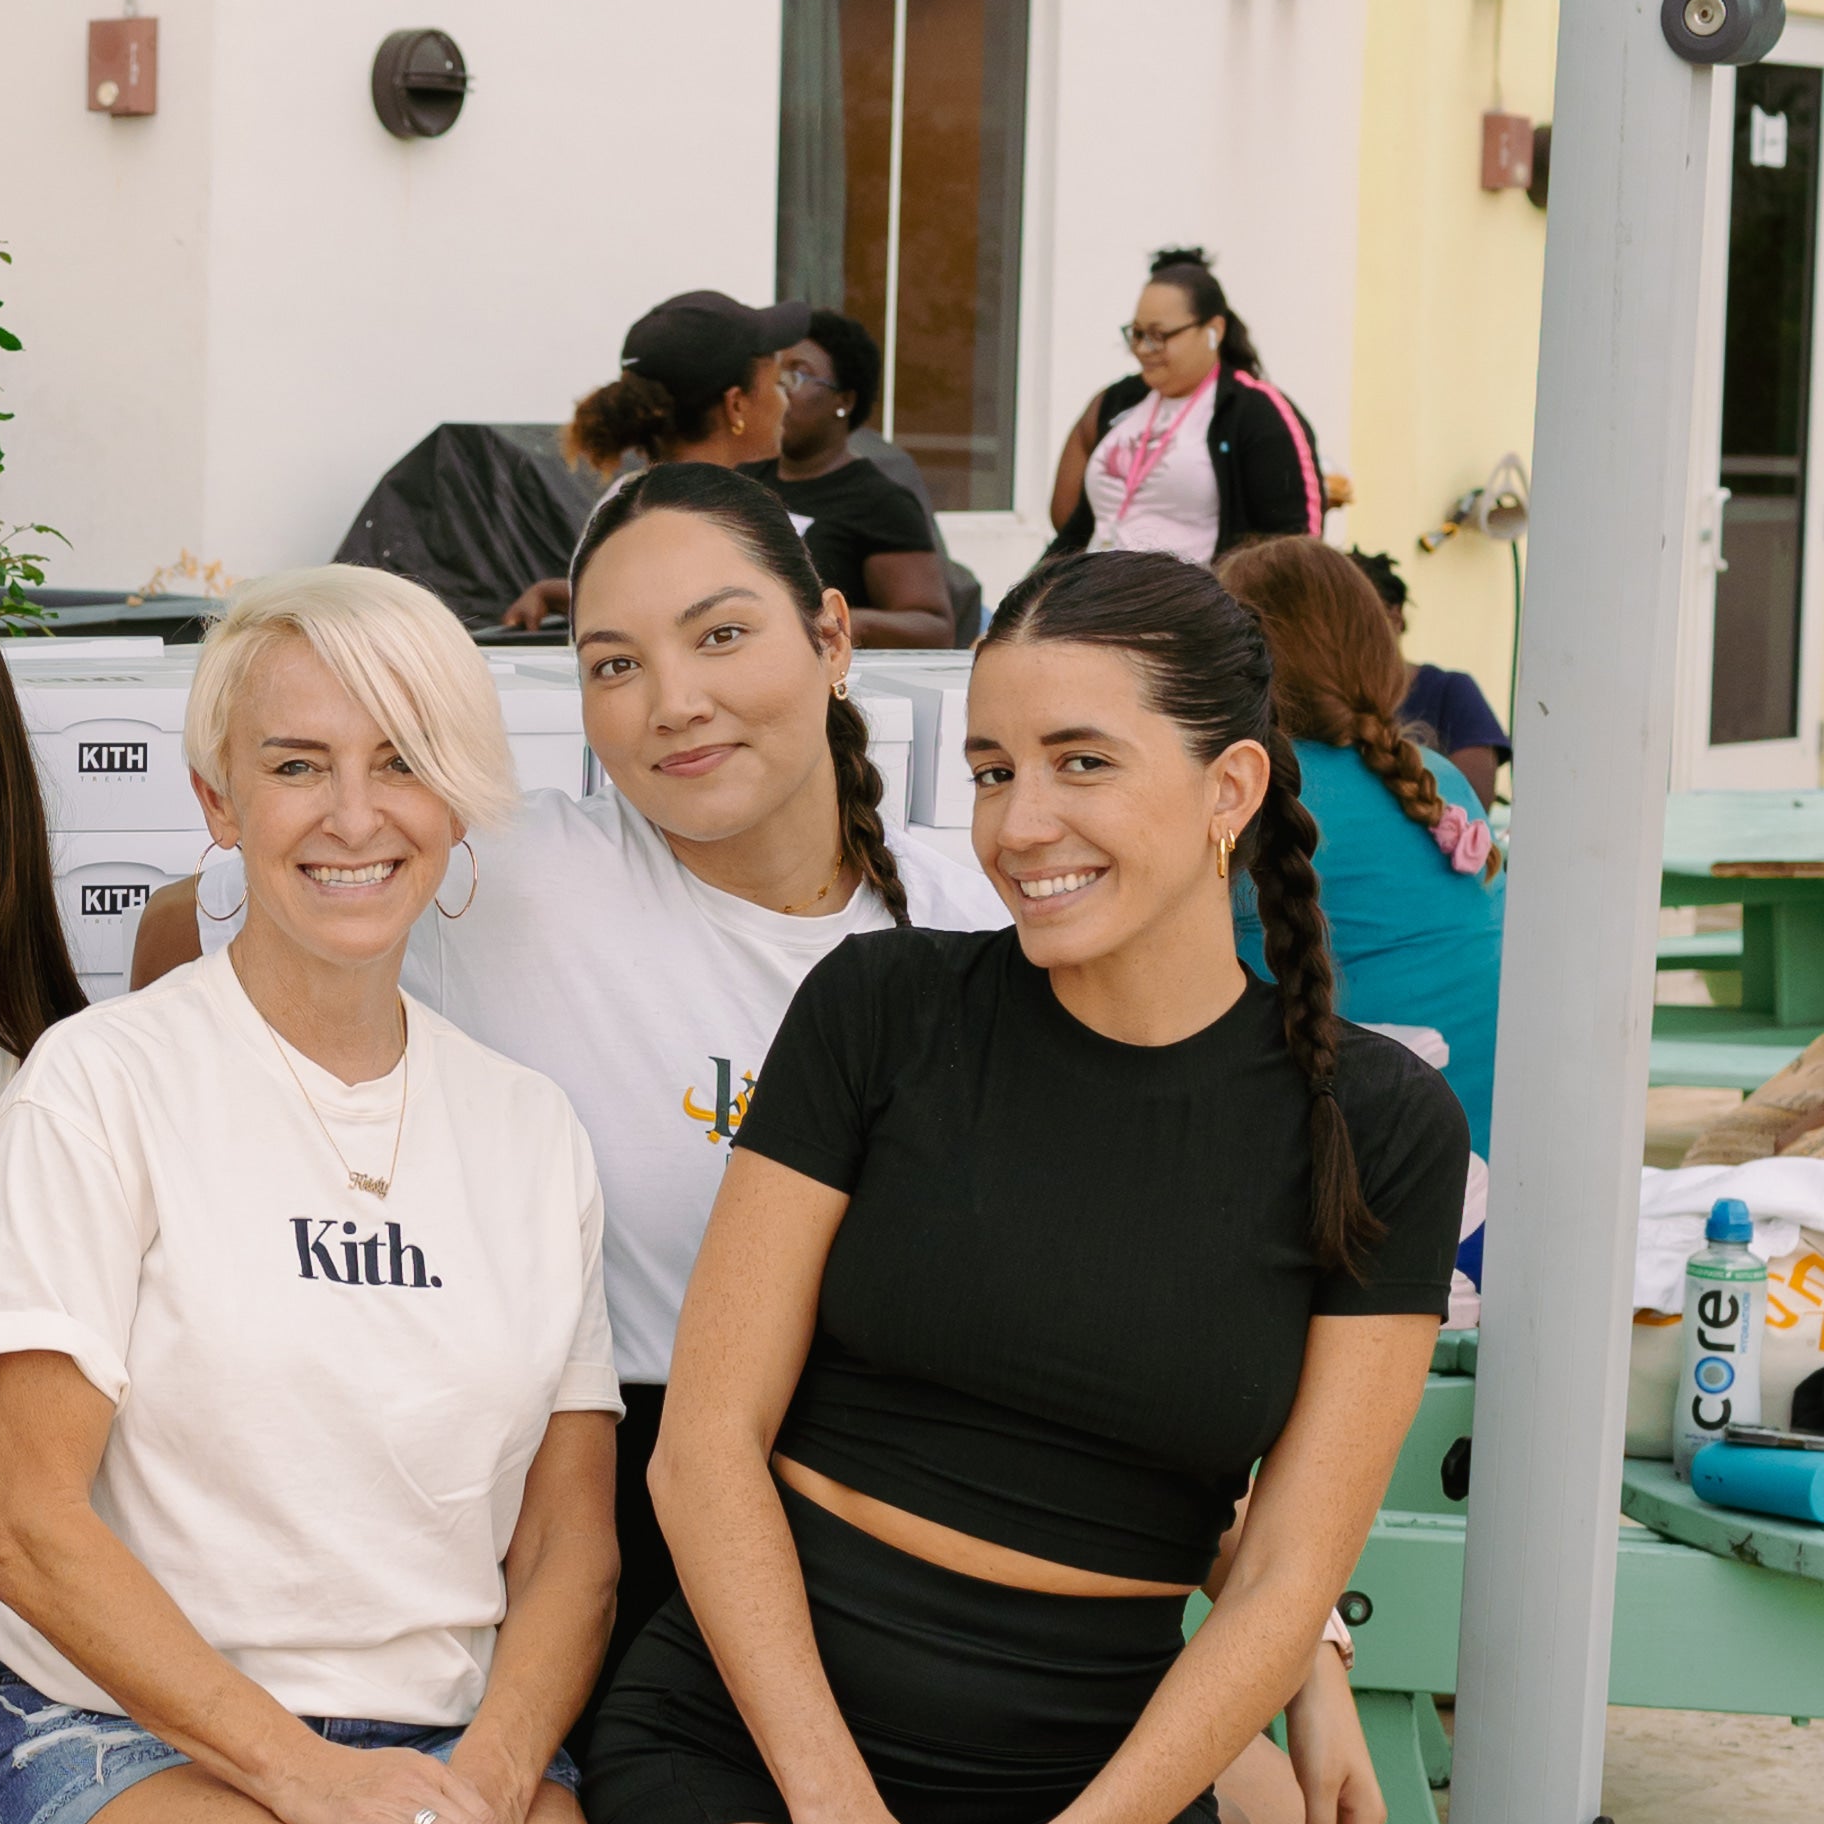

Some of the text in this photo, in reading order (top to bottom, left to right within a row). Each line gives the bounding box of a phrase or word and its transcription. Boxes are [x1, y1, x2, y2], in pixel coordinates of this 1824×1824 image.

[82, 746, 145, 769] KITH
[85, 889, 146, 911] KITH
[289, 1217, 443, 1288] Kith.
[1692, 1290, 1739, 1431] core
